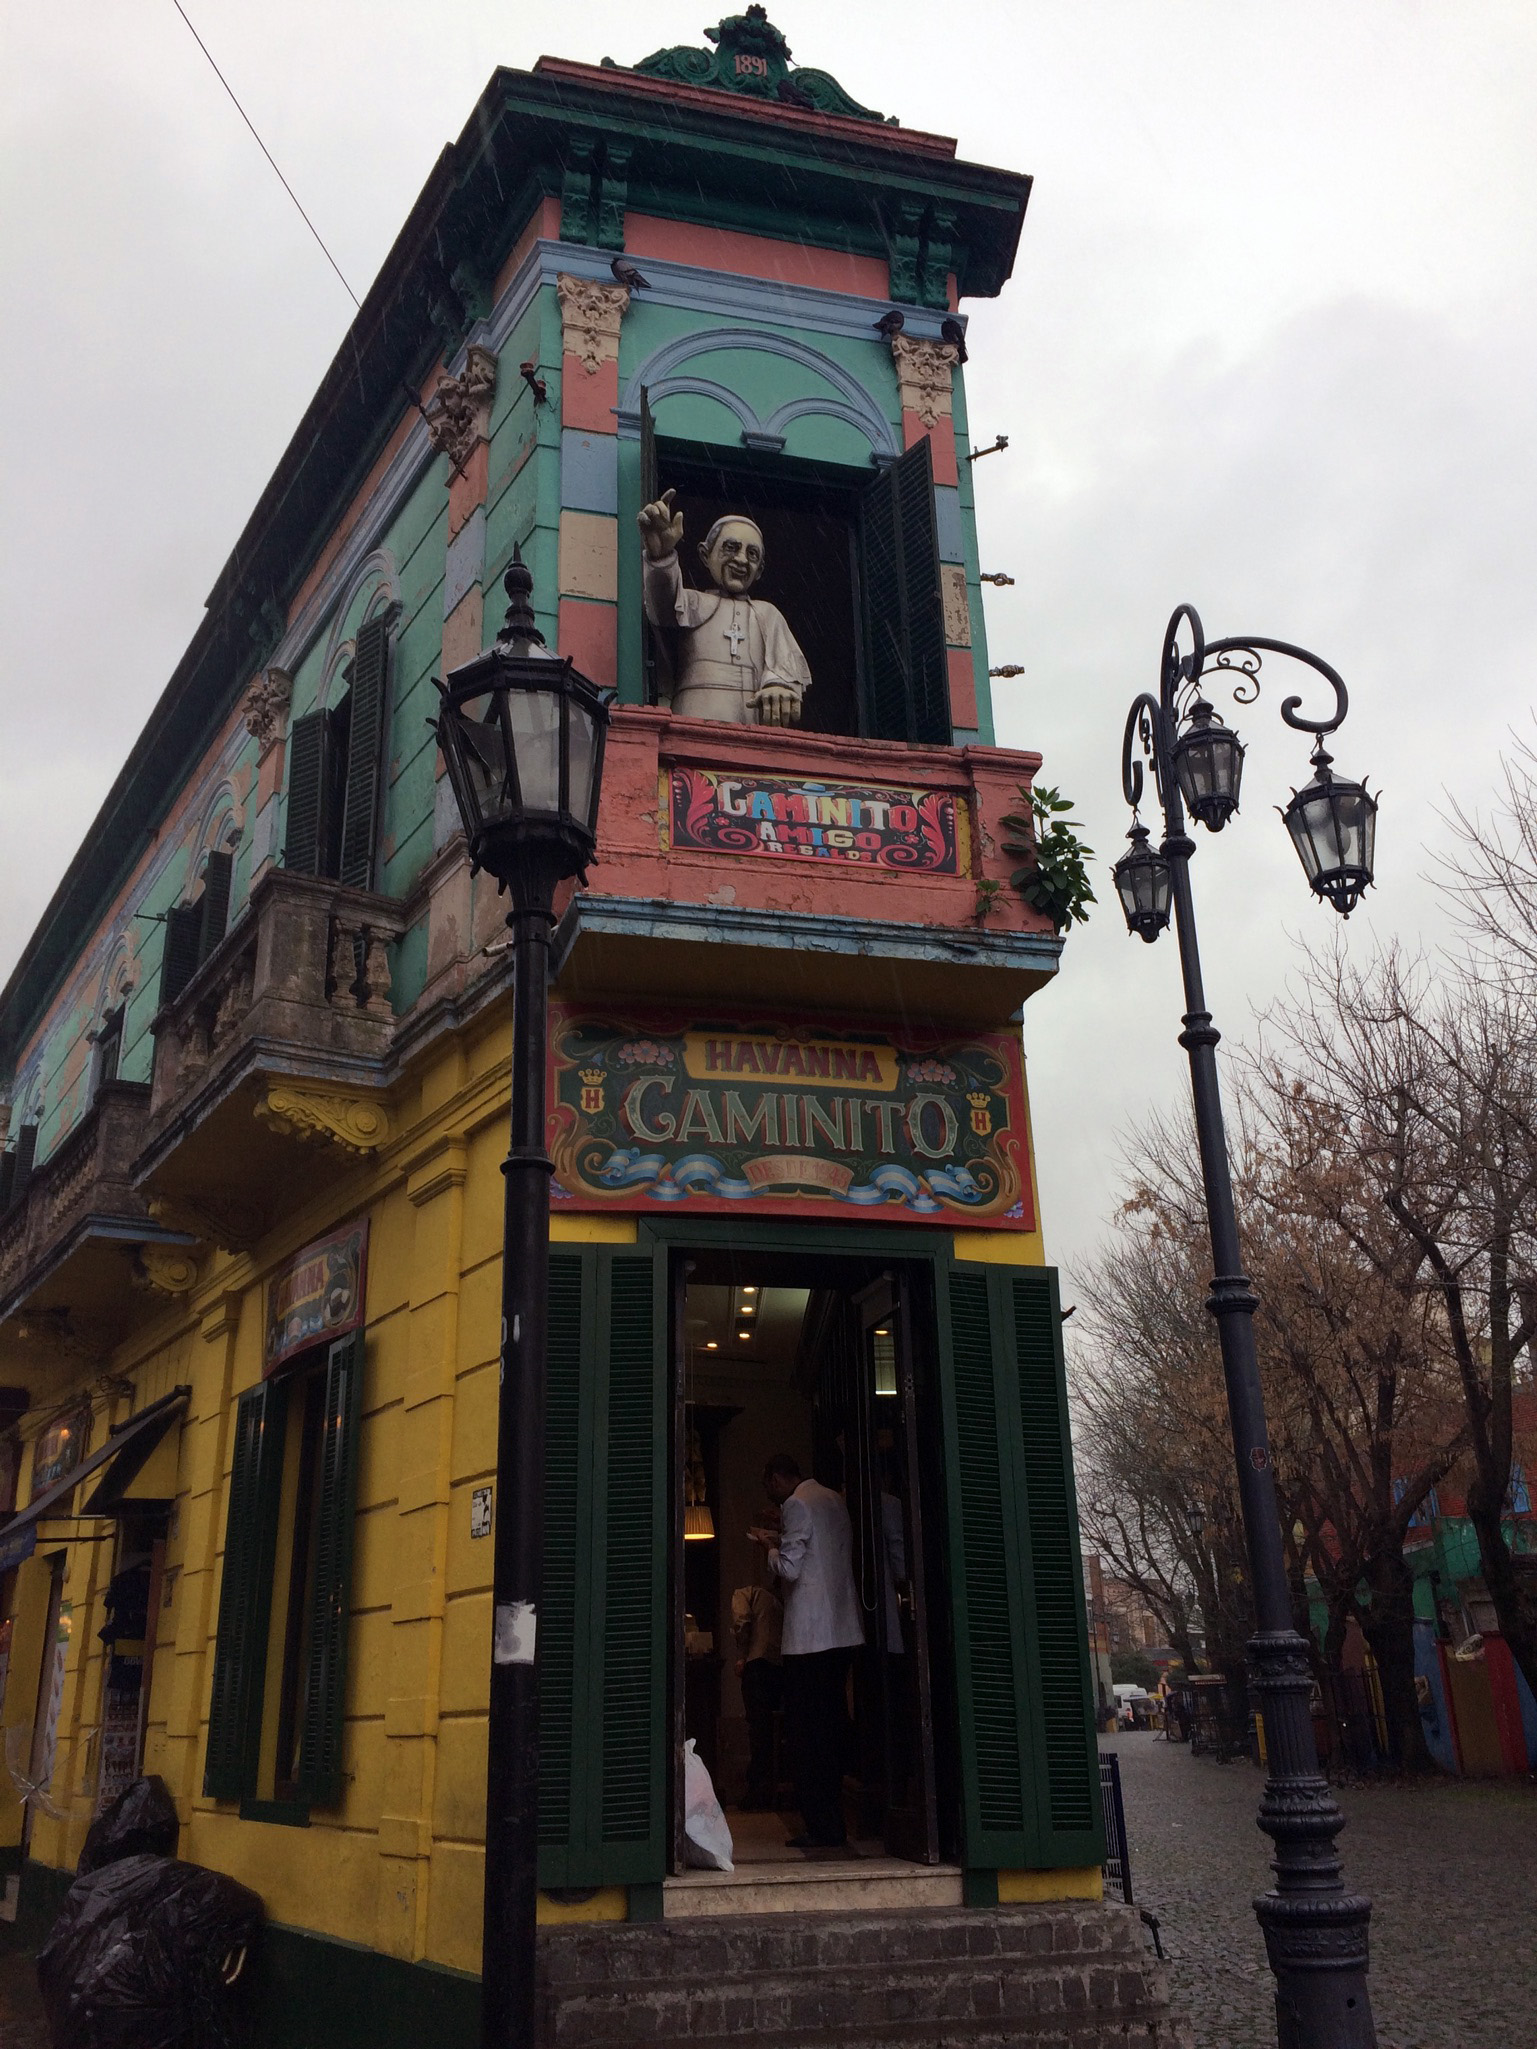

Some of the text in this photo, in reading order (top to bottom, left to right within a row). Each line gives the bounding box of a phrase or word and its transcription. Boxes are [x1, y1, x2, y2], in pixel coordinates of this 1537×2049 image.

[734, 55, 768, 77] 1891
[718, 782, 919, 832] CAMINITO
[757, 821, 882, 850] AMIGO
[705, 1039, 883, 1083] HAVANNA
[585, 1089, 600, 1108] H
[622, 1075, 959, 1158] CAMINITO
[974, 1111, 987, 1131] H
[748, 1160, 808, 1184] DESDE
